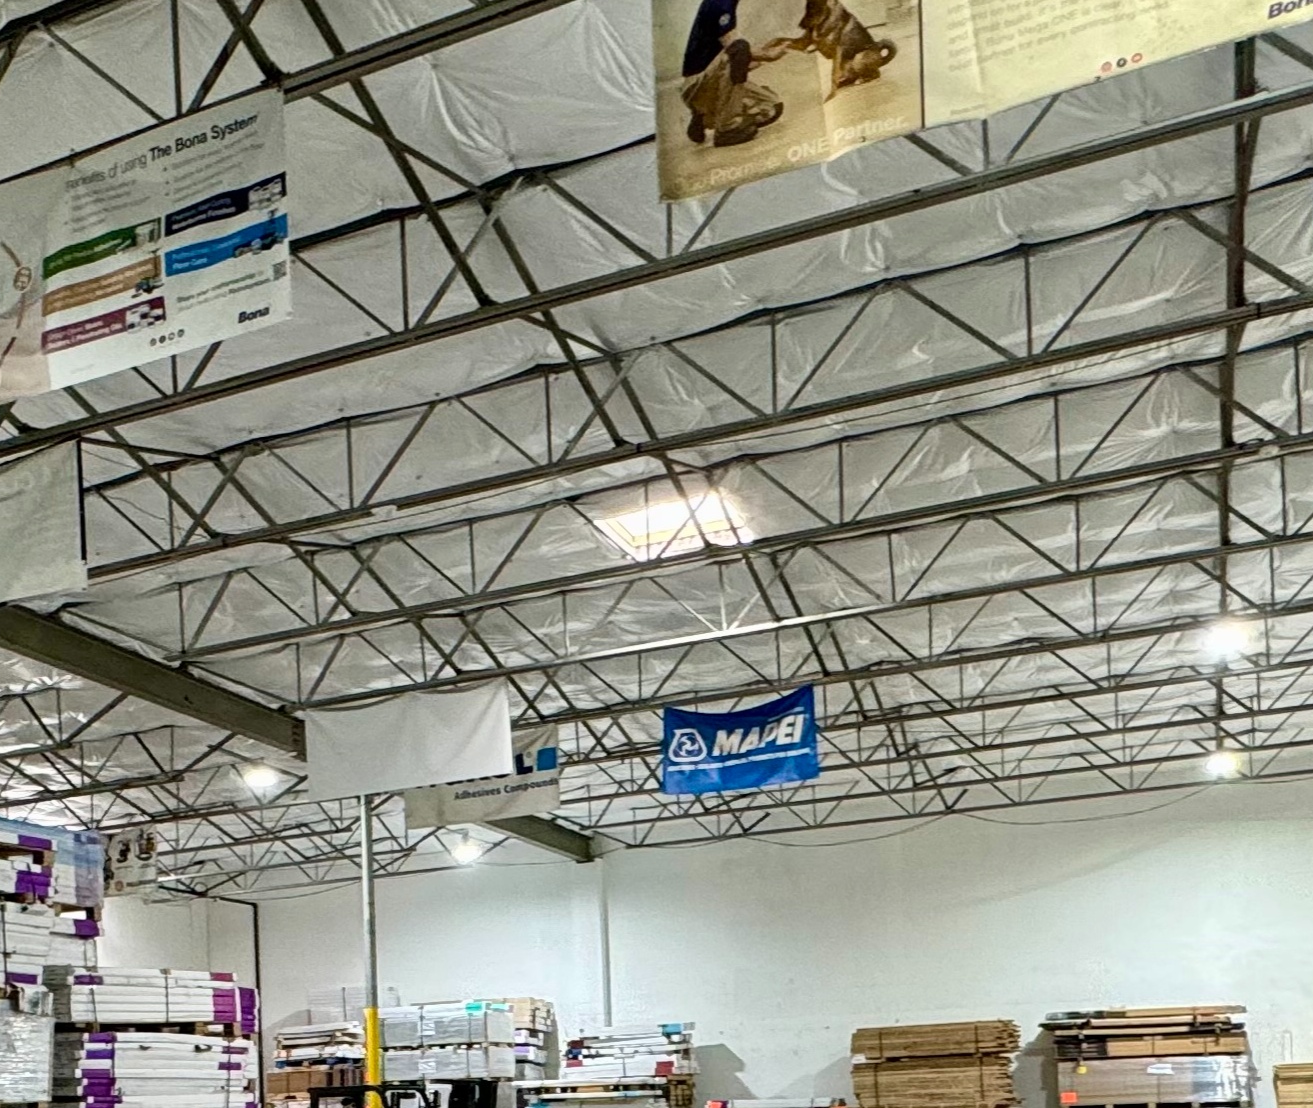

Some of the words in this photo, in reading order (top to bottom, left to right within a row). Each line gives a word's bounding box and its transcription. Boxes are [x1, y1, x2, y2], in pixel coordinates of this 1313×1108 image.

[149, 143, 173, 162] The
[175, 132, 208, 153] Bona
[211, 113, 259, 140] System
[787, 140, 830, 162] ONE
[238, 305, 270, 324] Bona
[711, 713, 806, 757] MAPEI
[454, 785, 502, 800] Adhesives
